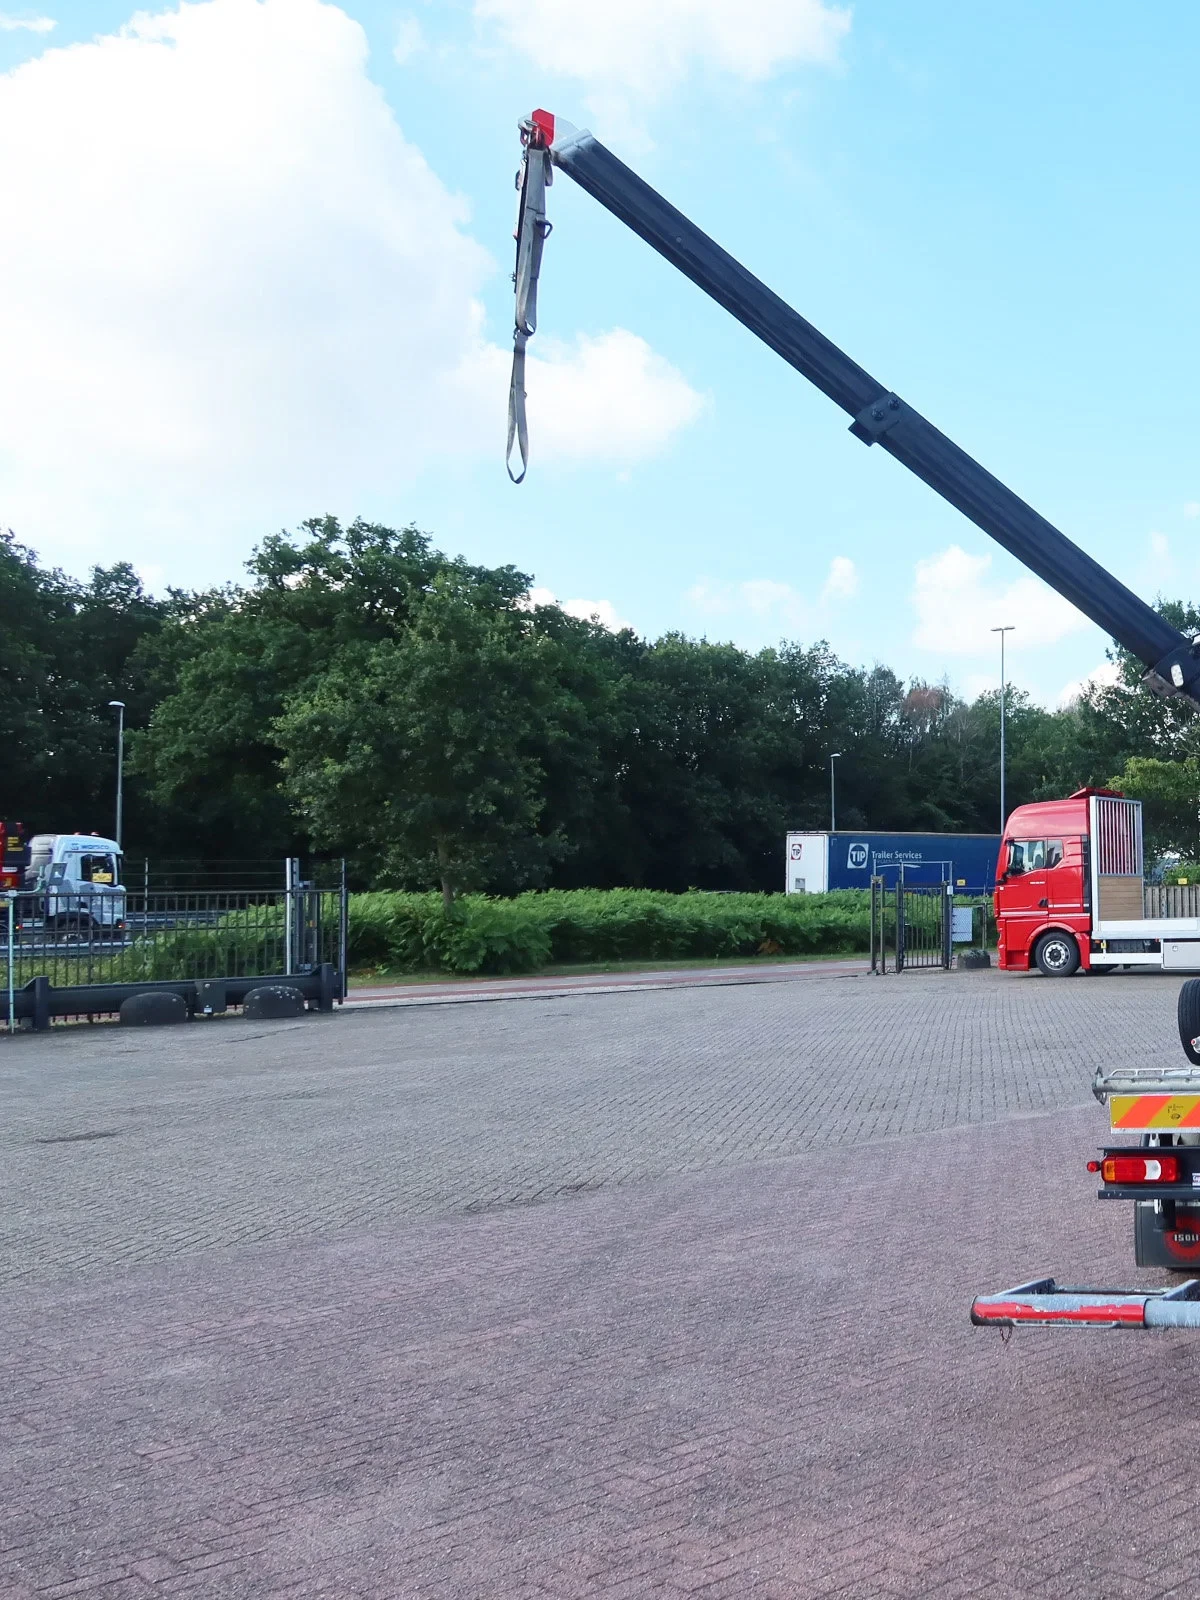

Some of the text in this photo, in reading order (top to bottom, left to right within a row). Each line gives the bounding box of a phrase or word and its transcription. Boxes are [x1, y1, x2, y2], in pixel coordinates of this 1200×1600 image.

[850, 850, 867, 862] TIP
[871, 850, 923, 859] Trailer Services
[1173, 1233, 1199, 1242] ISOLI
